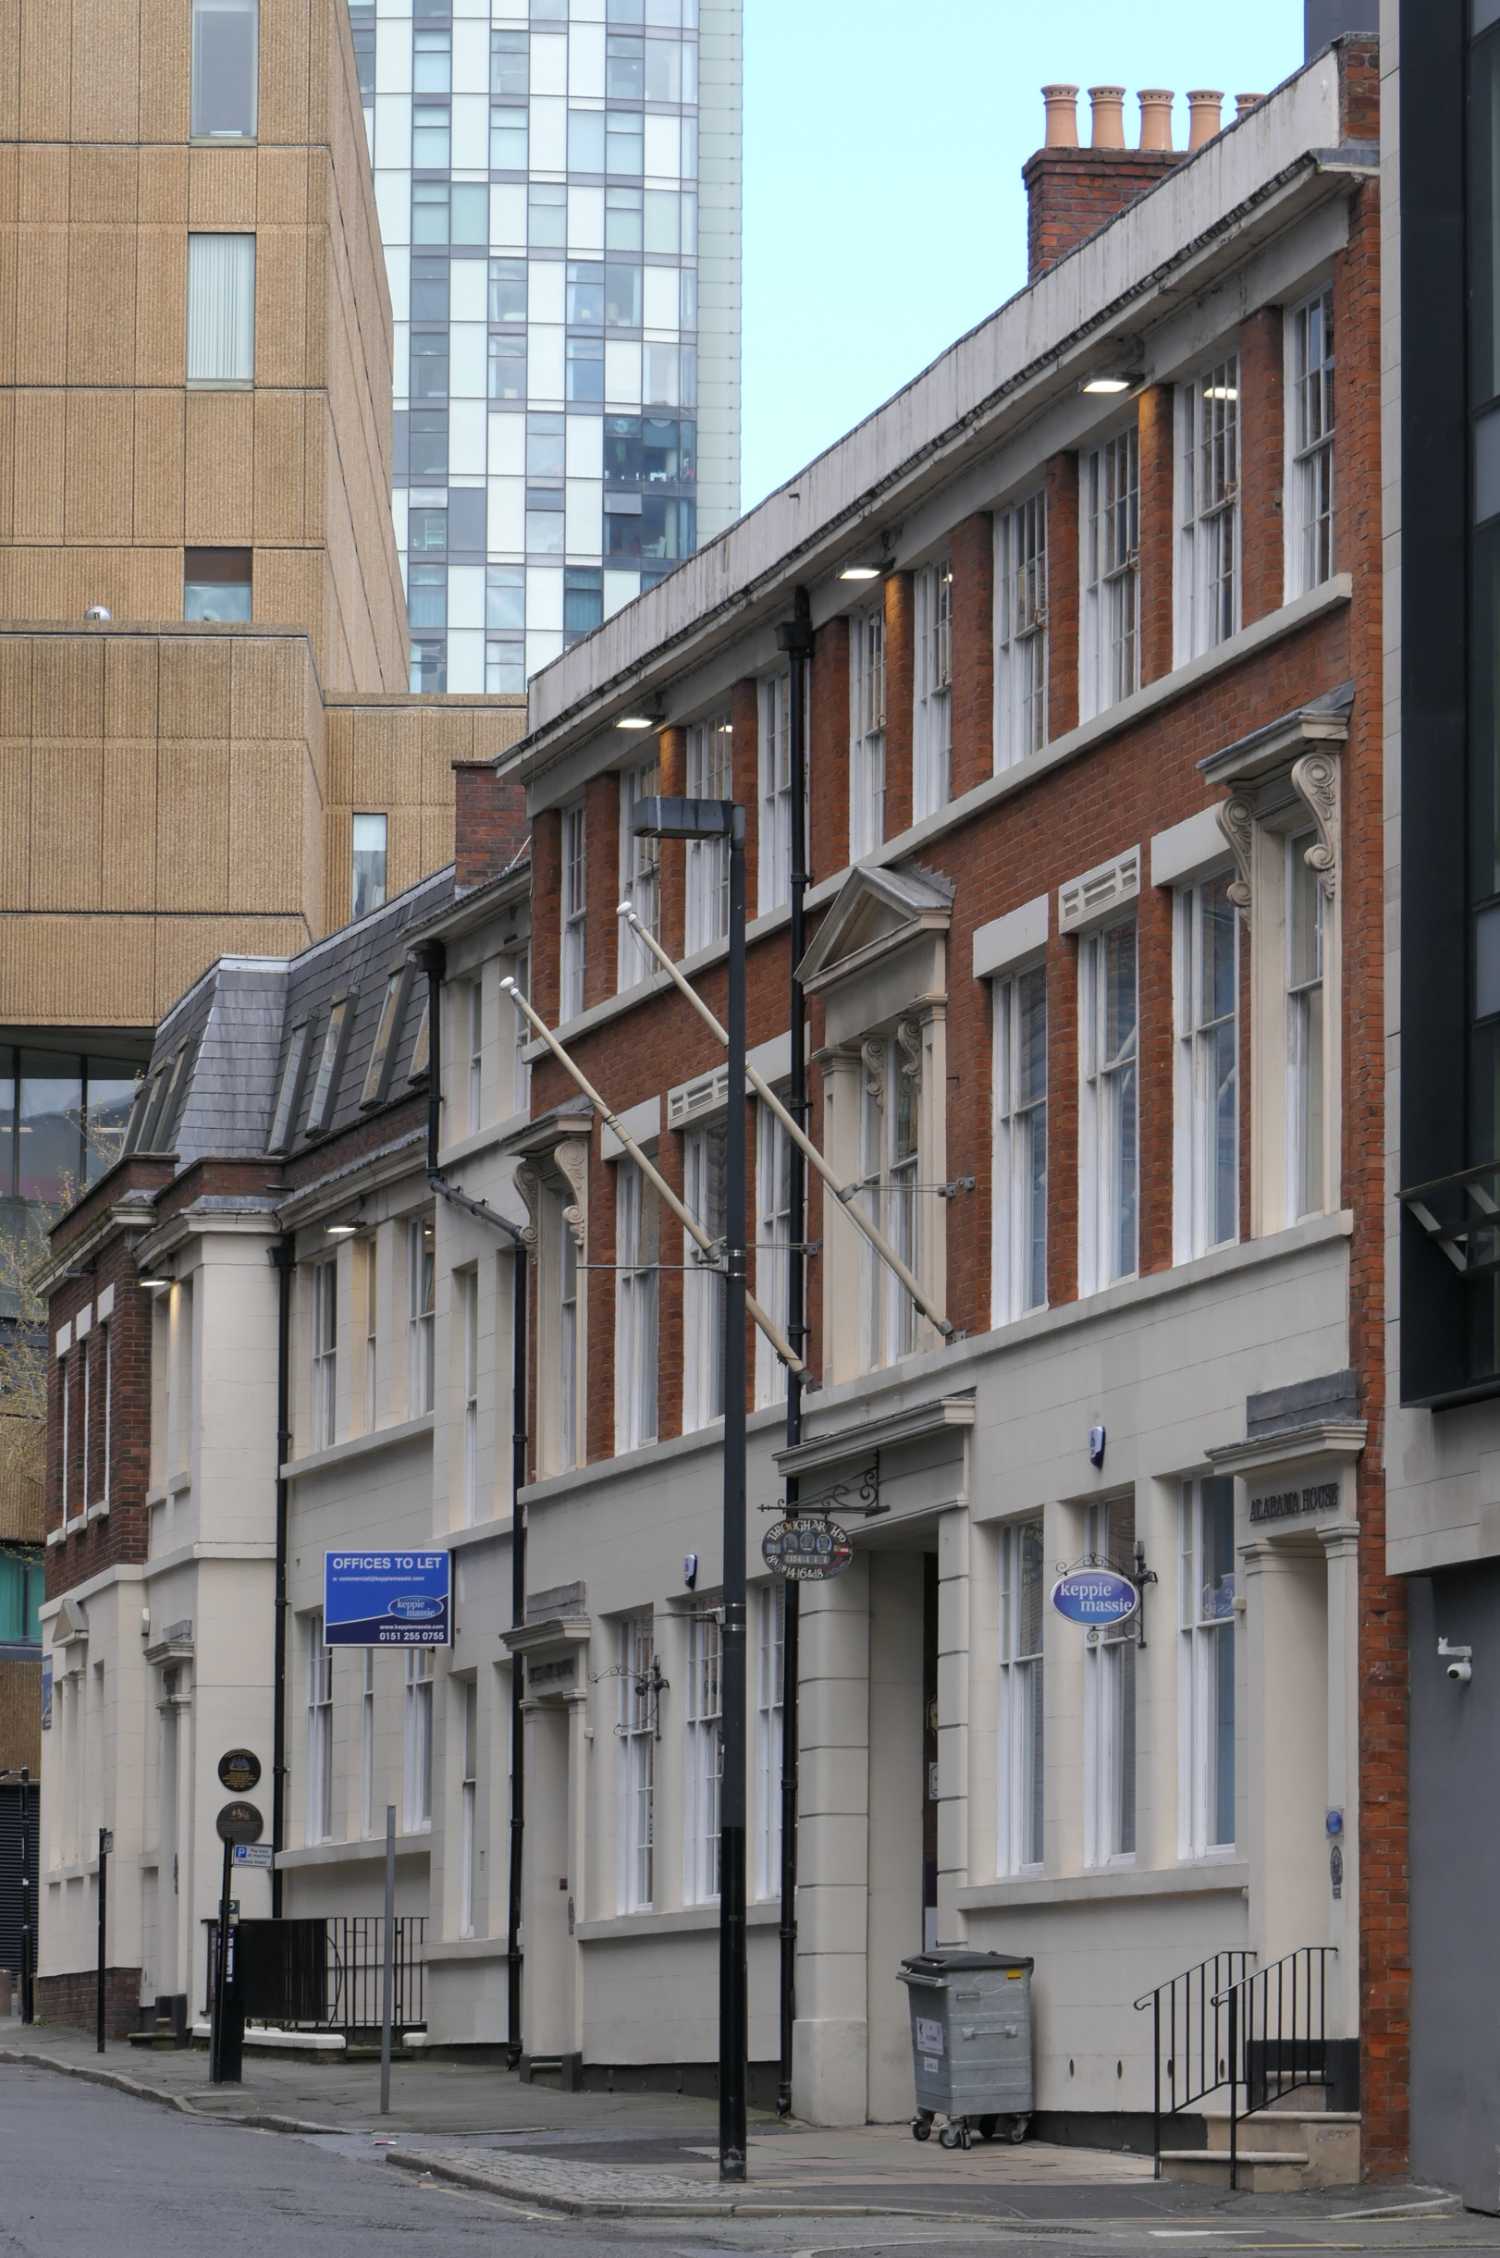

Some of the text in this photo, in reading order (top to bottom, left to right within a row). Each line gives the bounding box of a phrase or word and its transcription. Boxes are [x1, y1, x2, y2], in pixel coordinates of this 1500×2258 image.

[1249, 1482, 1340, 1522] ALABAMA HOUSE
[332, 1557, 442, 1569] OFFICES TO LET
[1060, 1582, 1112, 1600] keppie
[1080, 1598, 1132, 1612] massie
[379, 1632, 445, 1641] 0151 255 0755
